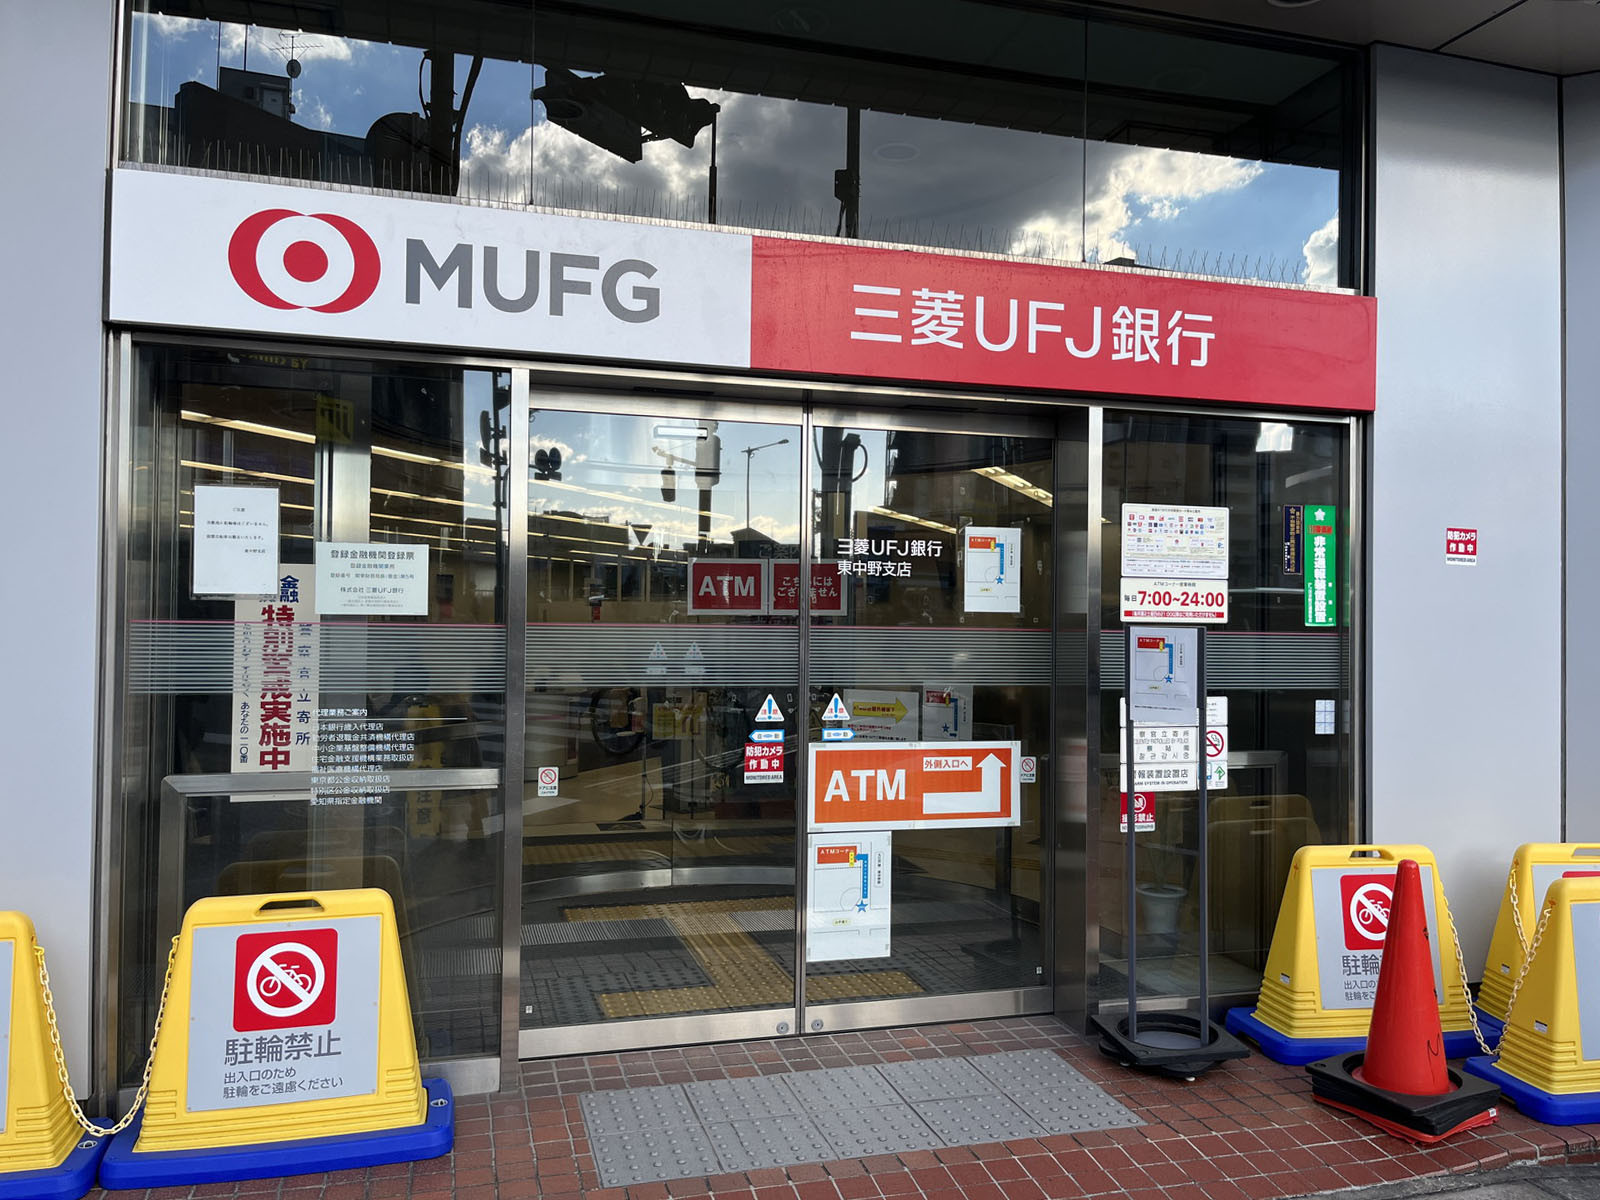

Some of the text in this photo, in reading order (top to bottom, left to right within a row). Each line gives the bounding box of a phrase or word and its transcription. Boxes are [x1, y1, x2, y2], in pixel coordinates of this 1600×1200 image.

[405, 239, 661, 323] MUFG
[850, 283, 1216, 368] 三菱UFJ銀行
[330, 549, 416, 560] 登録金融機関登録票
[836, 538, 943, 557] 三菱UFJ銀行
[836, 561, 912, 577] 東中野支店
[698, 576, 755, 597] ATM
[1124, 594, 1137, 602] 毎日
[1139, 730, 1190, 738] 察官立寄所
[745, 745, 784, 757] 防犯カメラ
[1138, 752, 1190, 760] 찰관감시중
[749, 759, 780, 770] 作動中
[924, 758, 969, 769] 外側入口へ
[1134, 769, 1190, 779] 報装置設置店
[823, 768, 906, 802] ATM
[1342, 954, 1382, 976] 駐輪
[1343, 979, 1376, 990] 出入口の
[223, 1030, 342, 1066] 駐輪禁止
[223, 1067, 297, 1085] 出入口のため
[222, 1077, 344, 1100] 駐輪をご遠慮ください
